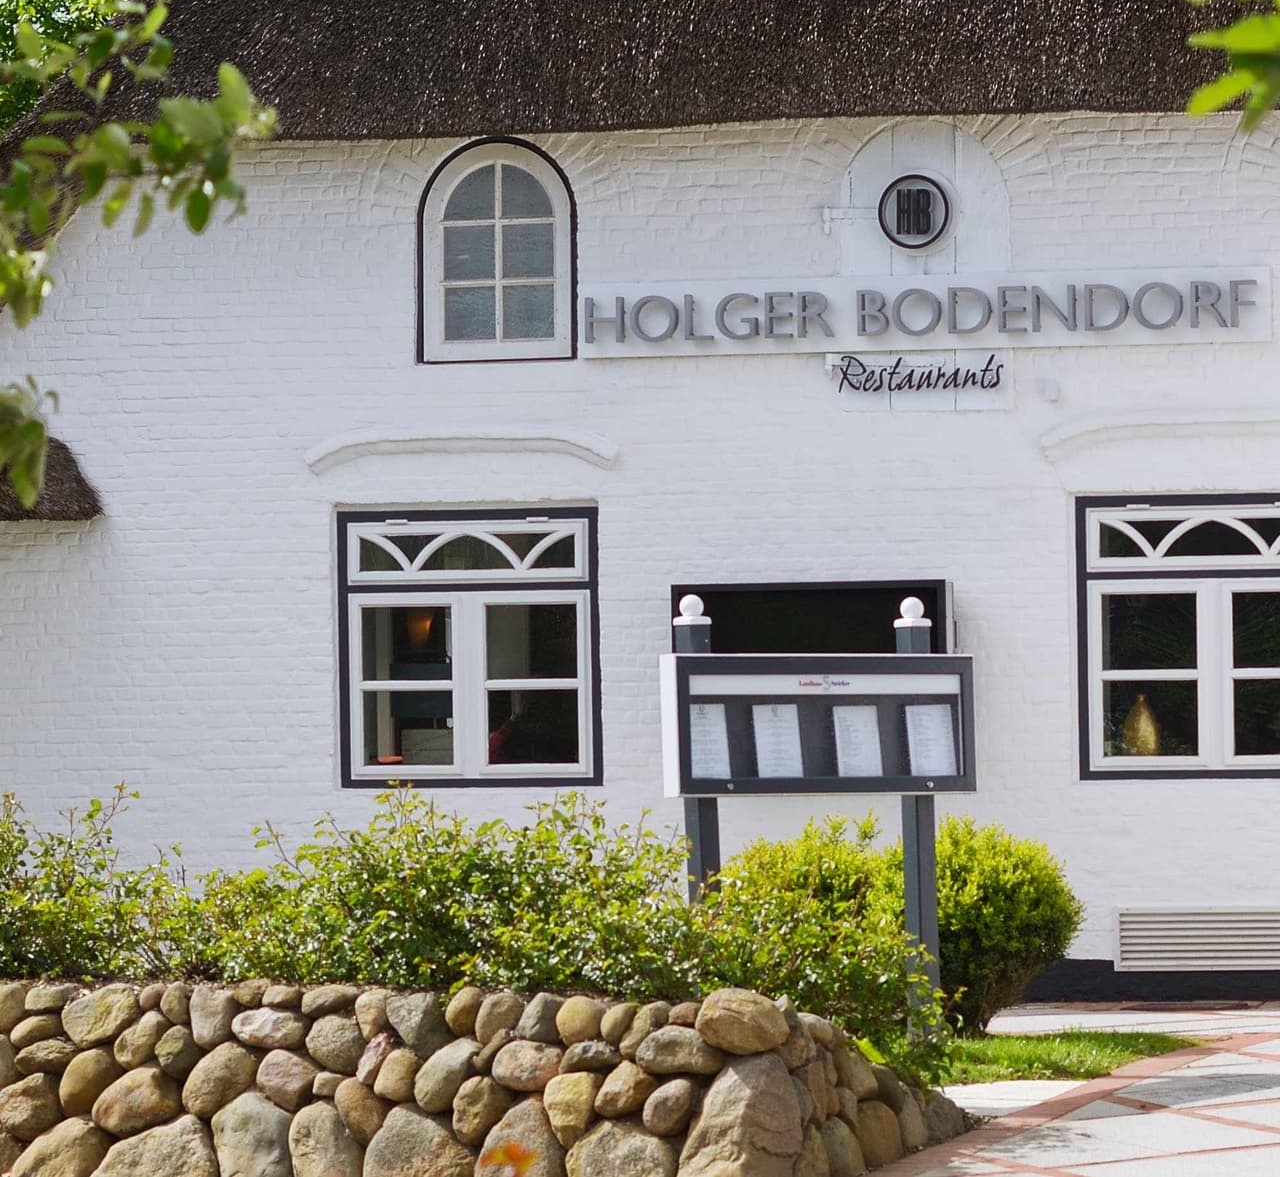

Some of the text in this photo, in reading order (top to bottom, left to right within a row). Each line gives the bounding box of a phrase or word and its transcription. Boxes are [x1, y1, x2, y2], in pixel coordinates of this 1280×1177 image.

[584, 279, 1258, 344] HOLGER BODENDORF
[838, 354, 1004, 394] Restaurants
